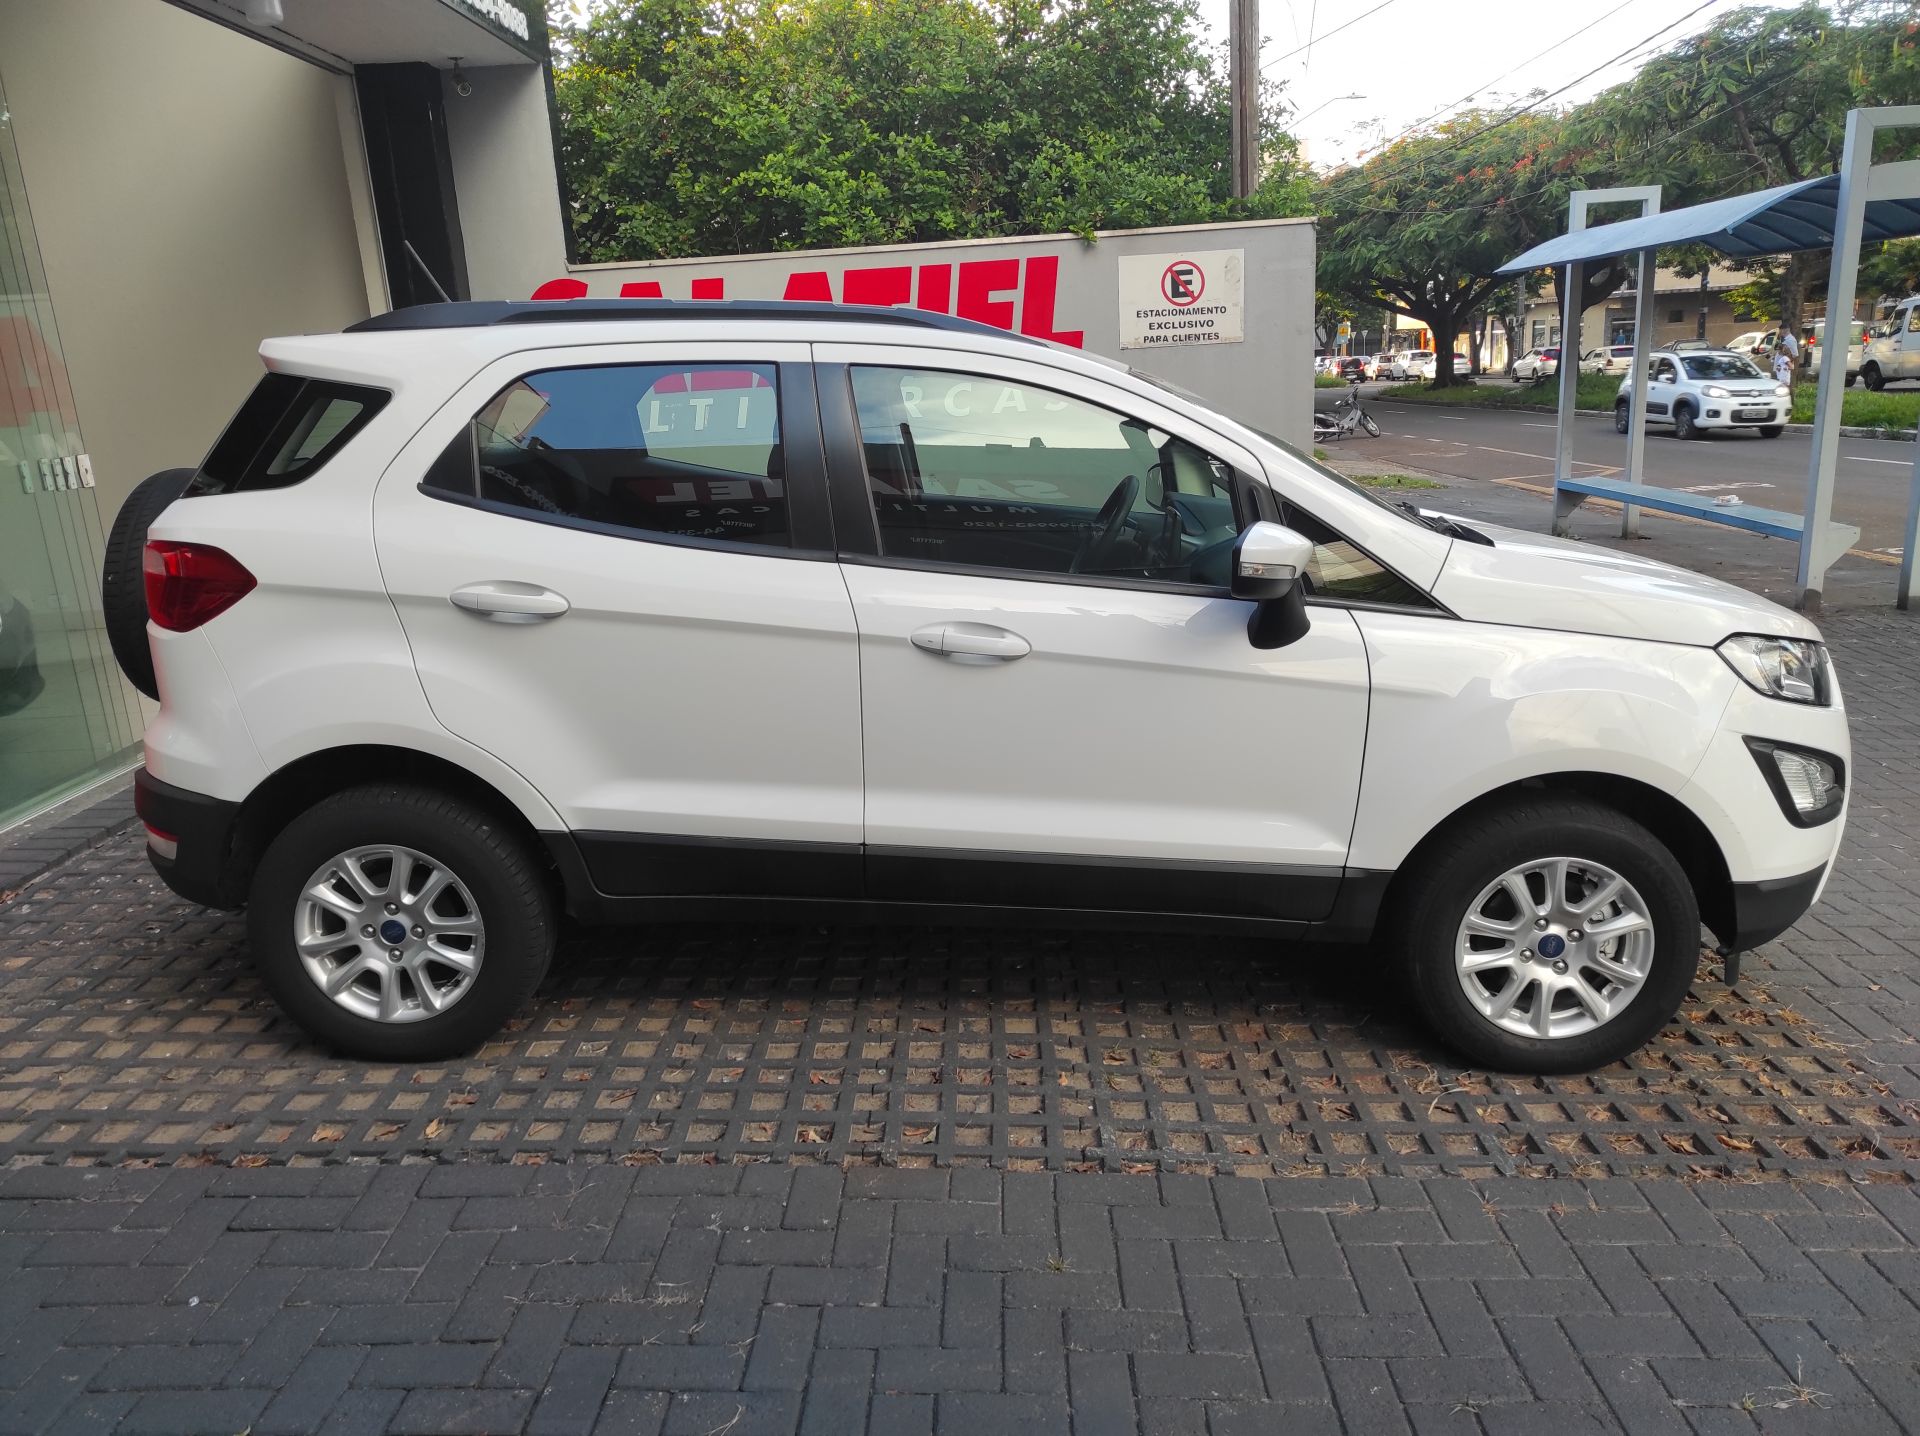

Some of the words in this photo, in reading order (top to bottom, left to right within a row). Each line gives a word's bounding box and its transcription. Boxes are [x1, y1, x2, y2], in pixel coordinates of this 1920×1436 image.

[1171, 269, 1194, 298] E
[1136, 306, 1227, 318] ESTACIONAMENTO
[1149, 319, 1214, 330] EXCLUSIVO
[1143, 335, 1169, 344] PARA
[1171, 332, 1220, 342] CLIENTES
